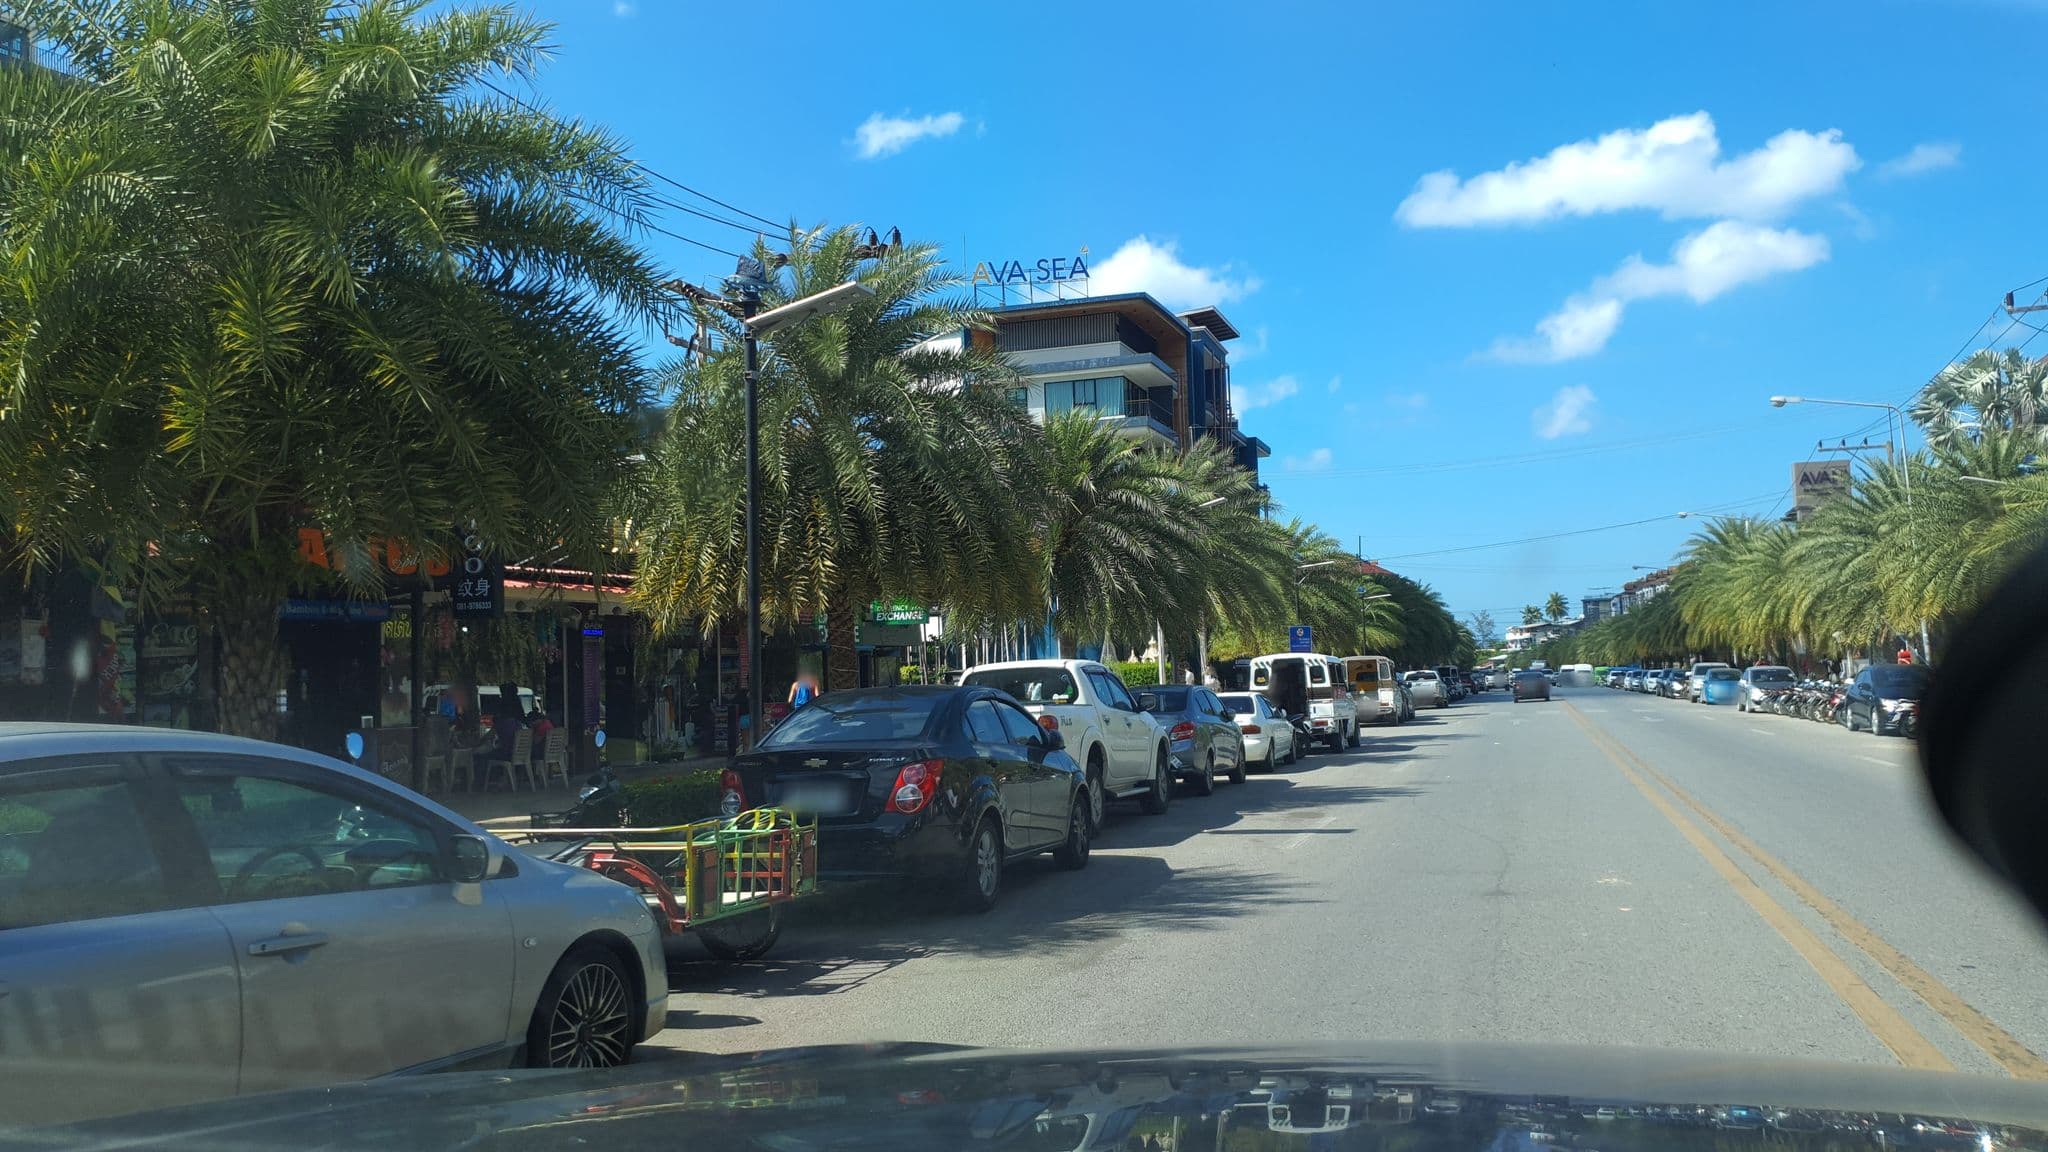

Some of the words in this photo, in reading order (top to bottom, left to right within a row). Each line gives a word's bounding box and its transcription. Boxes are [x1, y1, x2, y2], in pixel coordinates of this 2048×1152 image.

[972, 260, 1027, 284] AVA
[1037, 256, 1089, 282] SEA
[456, 577, 491, 597] 纹身
[876, 610, 924, 621] EXCHANGE
